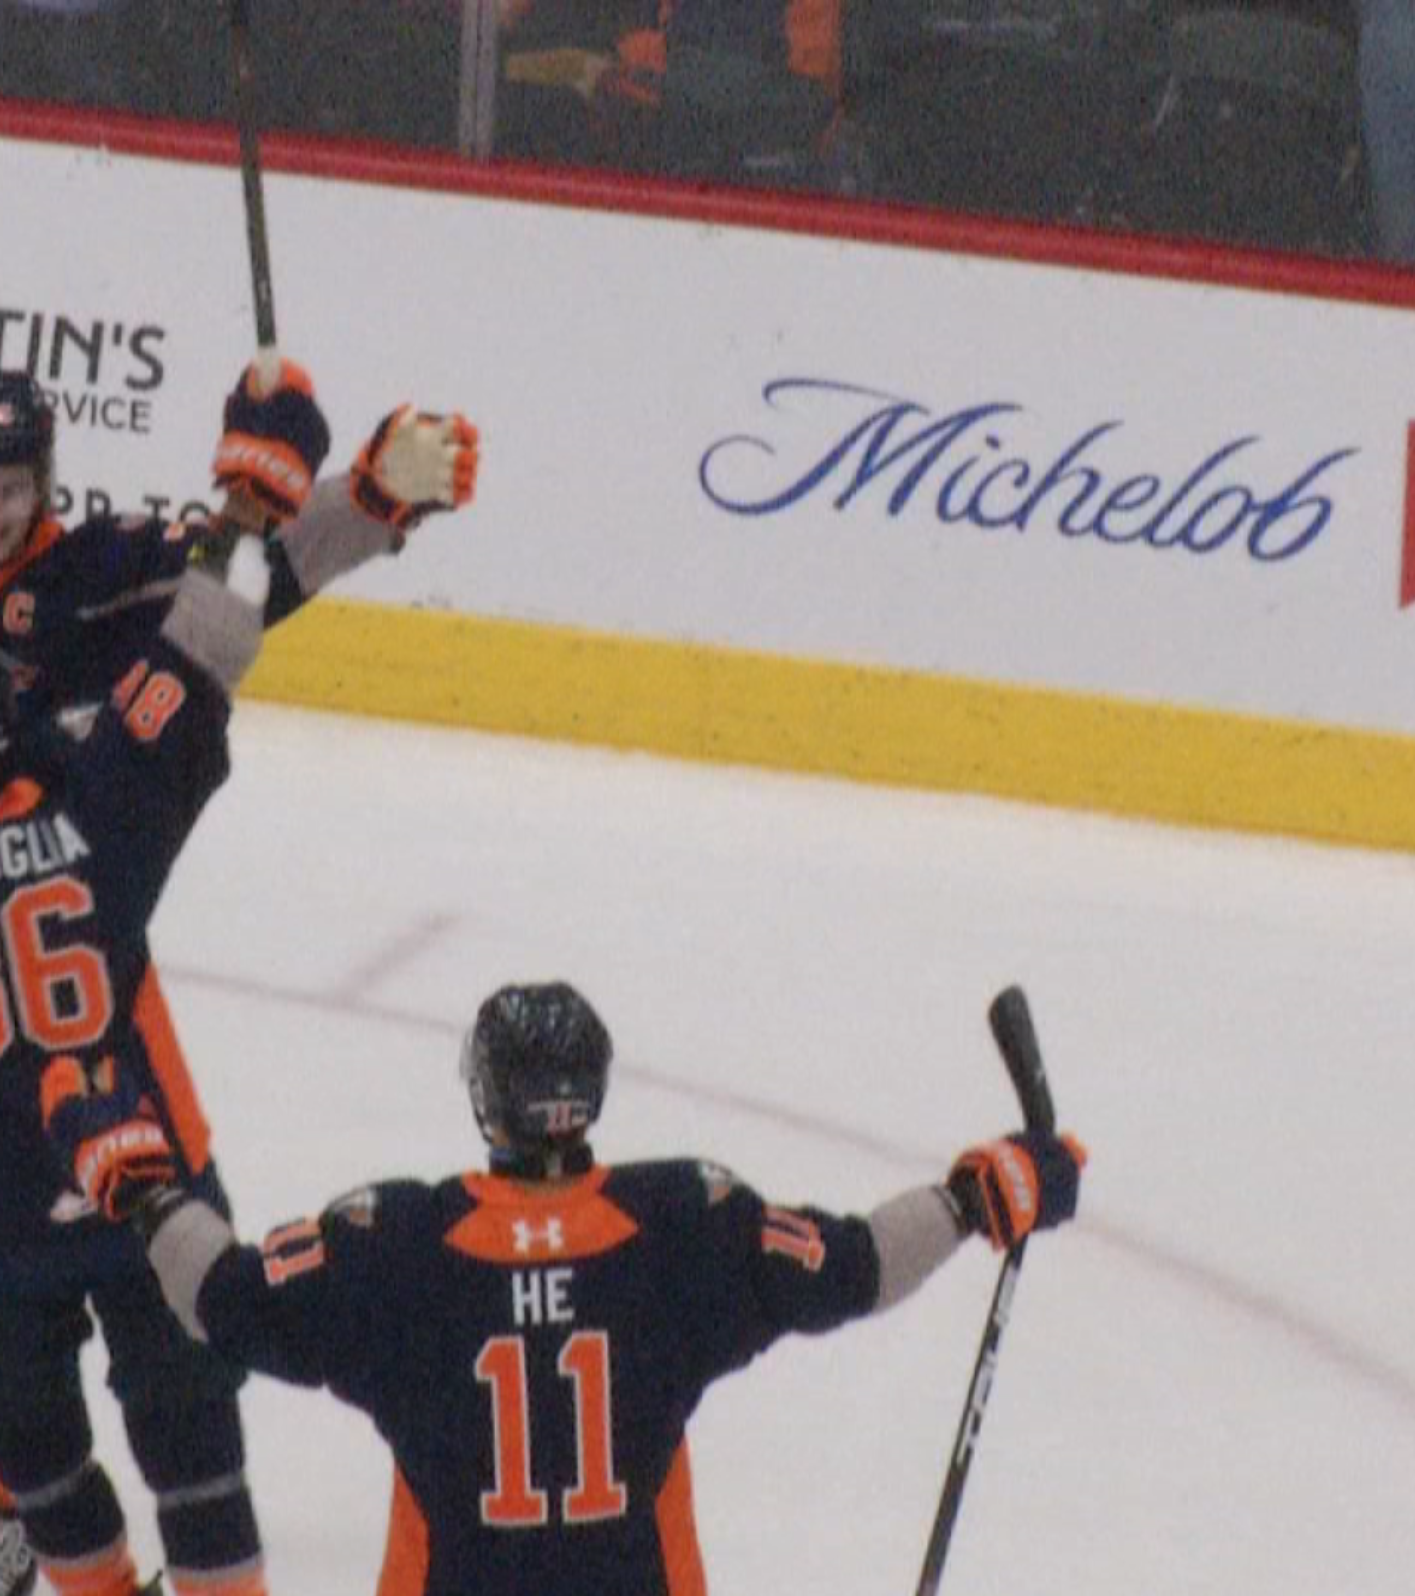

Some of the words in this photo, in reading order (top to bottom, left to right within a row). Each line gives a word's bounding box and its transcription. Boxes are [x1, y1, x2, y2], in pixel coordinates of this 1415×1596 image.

[700, 377, 1361, 563] Michelob
[512, 1268, 575, 1326] HE
[475, 1330, 628, 1528] 11
